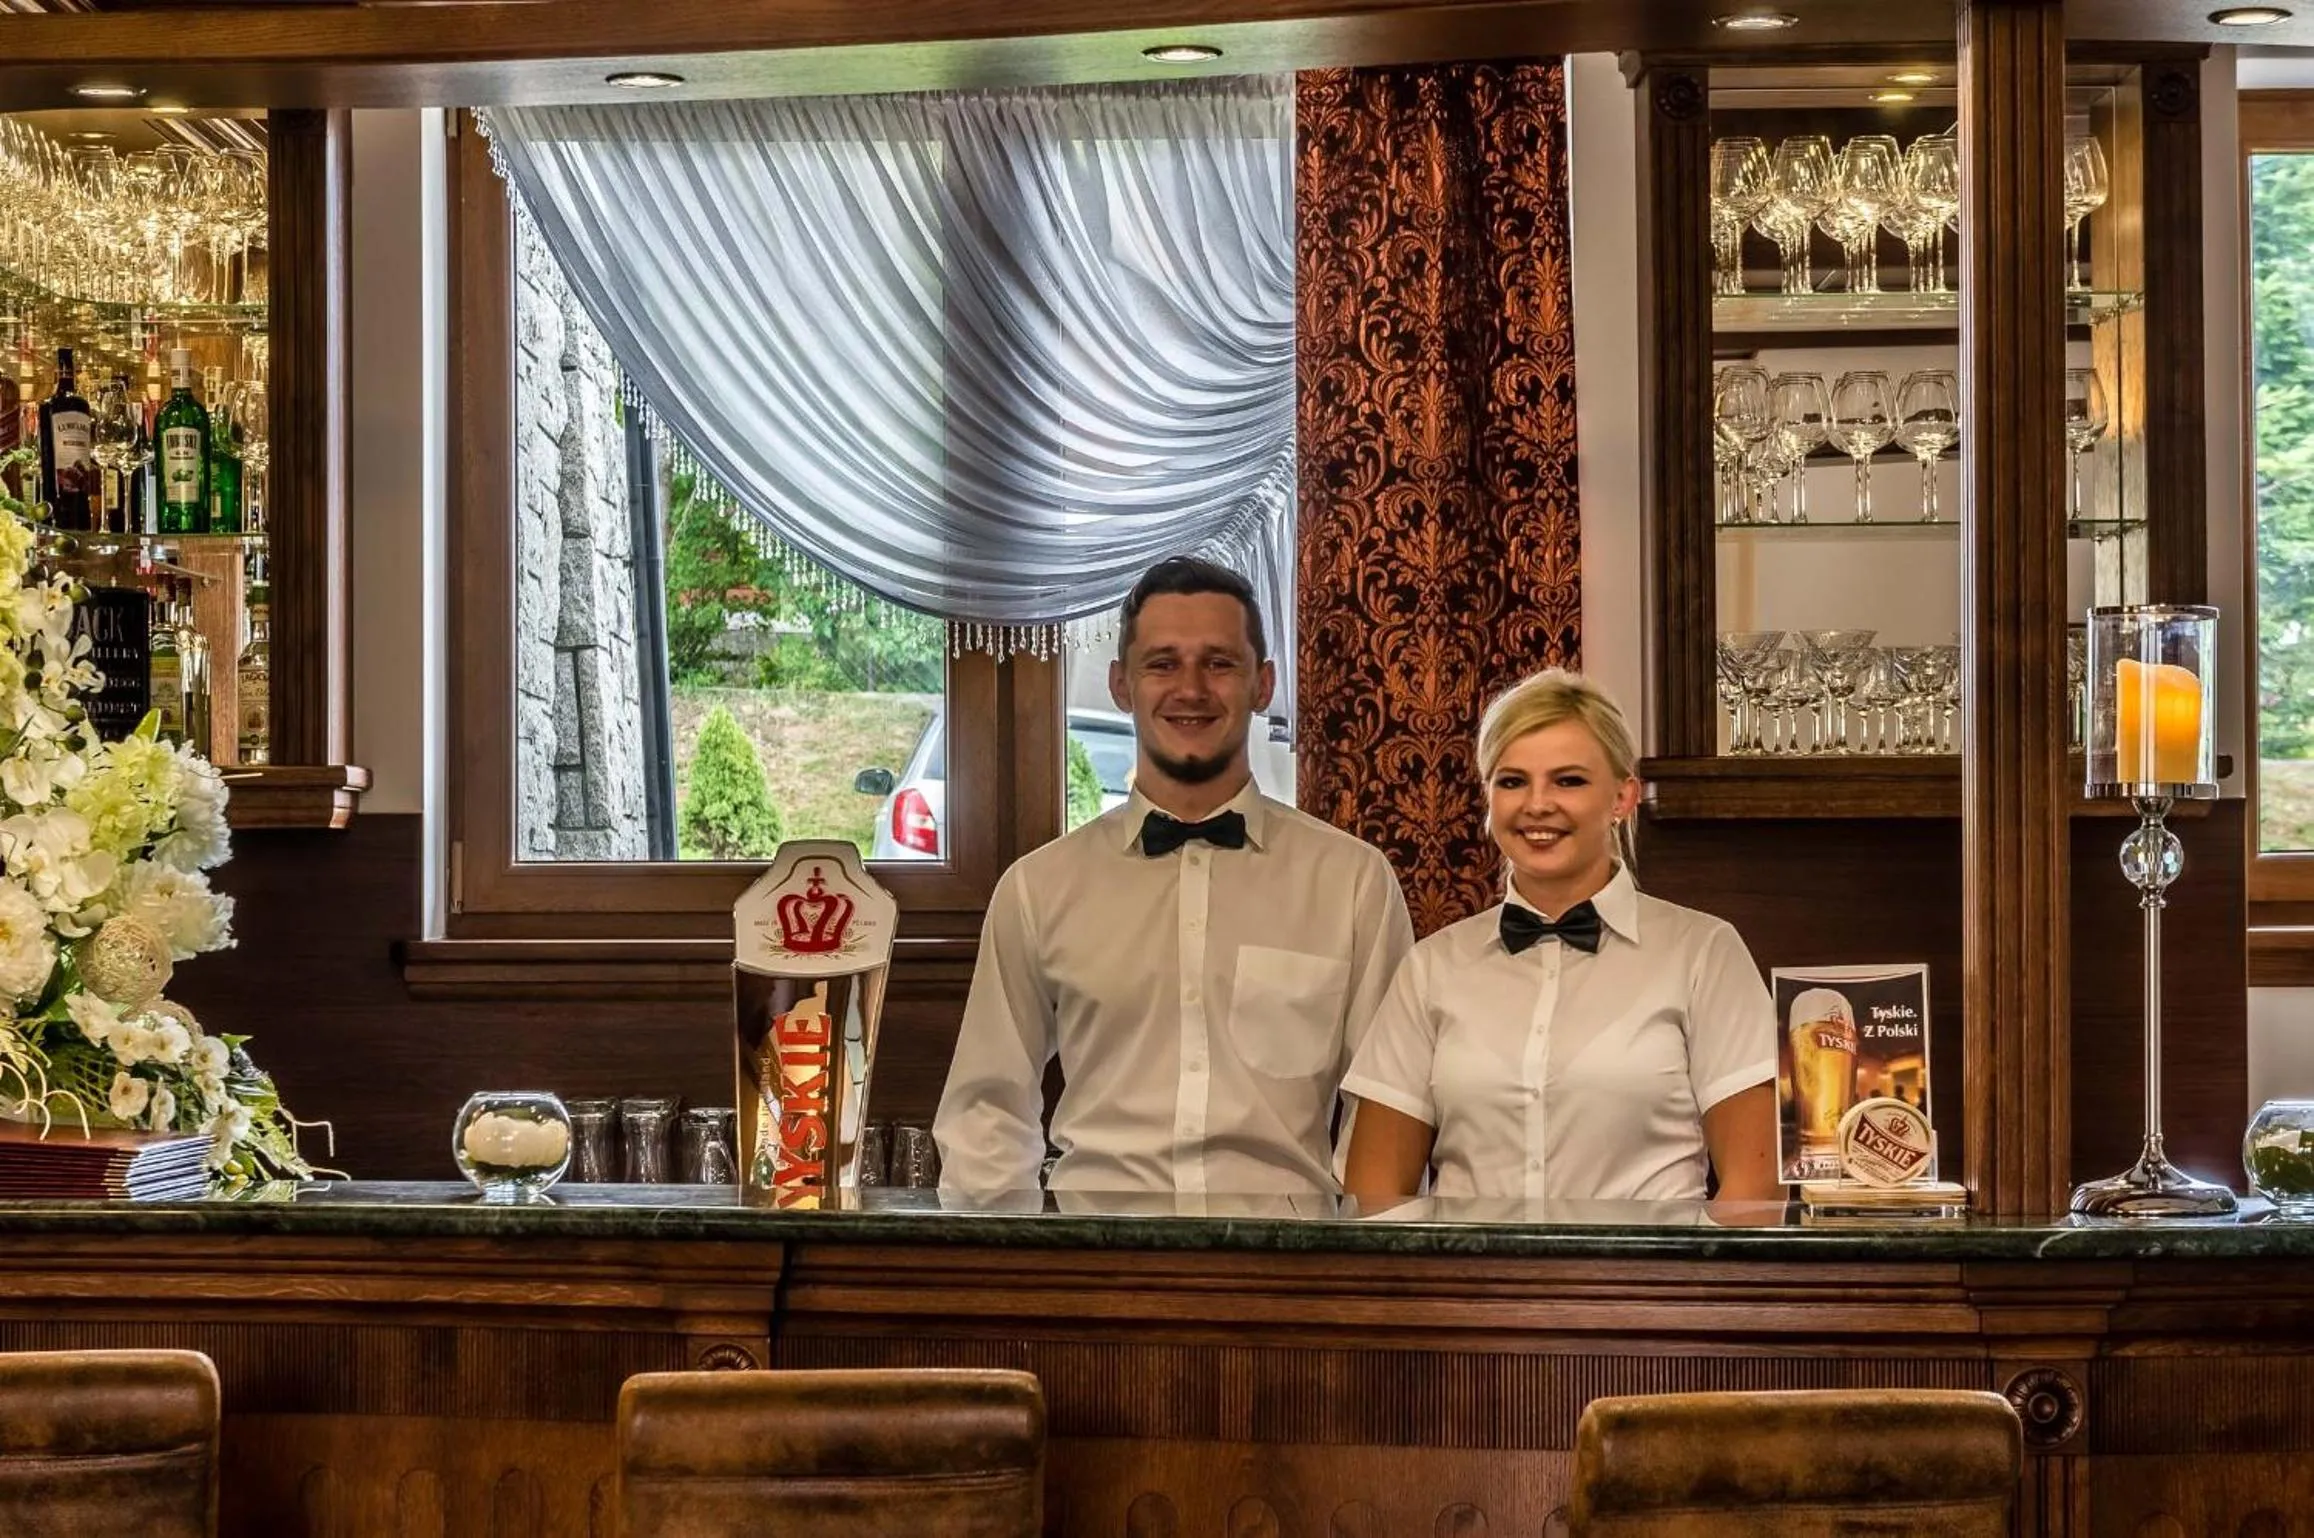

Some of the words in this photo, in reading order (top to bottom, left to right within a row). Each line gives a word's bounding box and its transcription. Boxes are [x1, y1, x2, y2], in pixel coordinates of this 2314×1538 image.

[73, 605, 125, 642] ACK
[1864, 1025, 1875, 1037] Z
[1877, 1023, 1918, 1037] Polski
[1870, 1004, 1918, 1023] Tyskie.
[773, 1012, 832, 1188] YSKIE
[1858, 1122, 1917, 1169] TYSKIE
